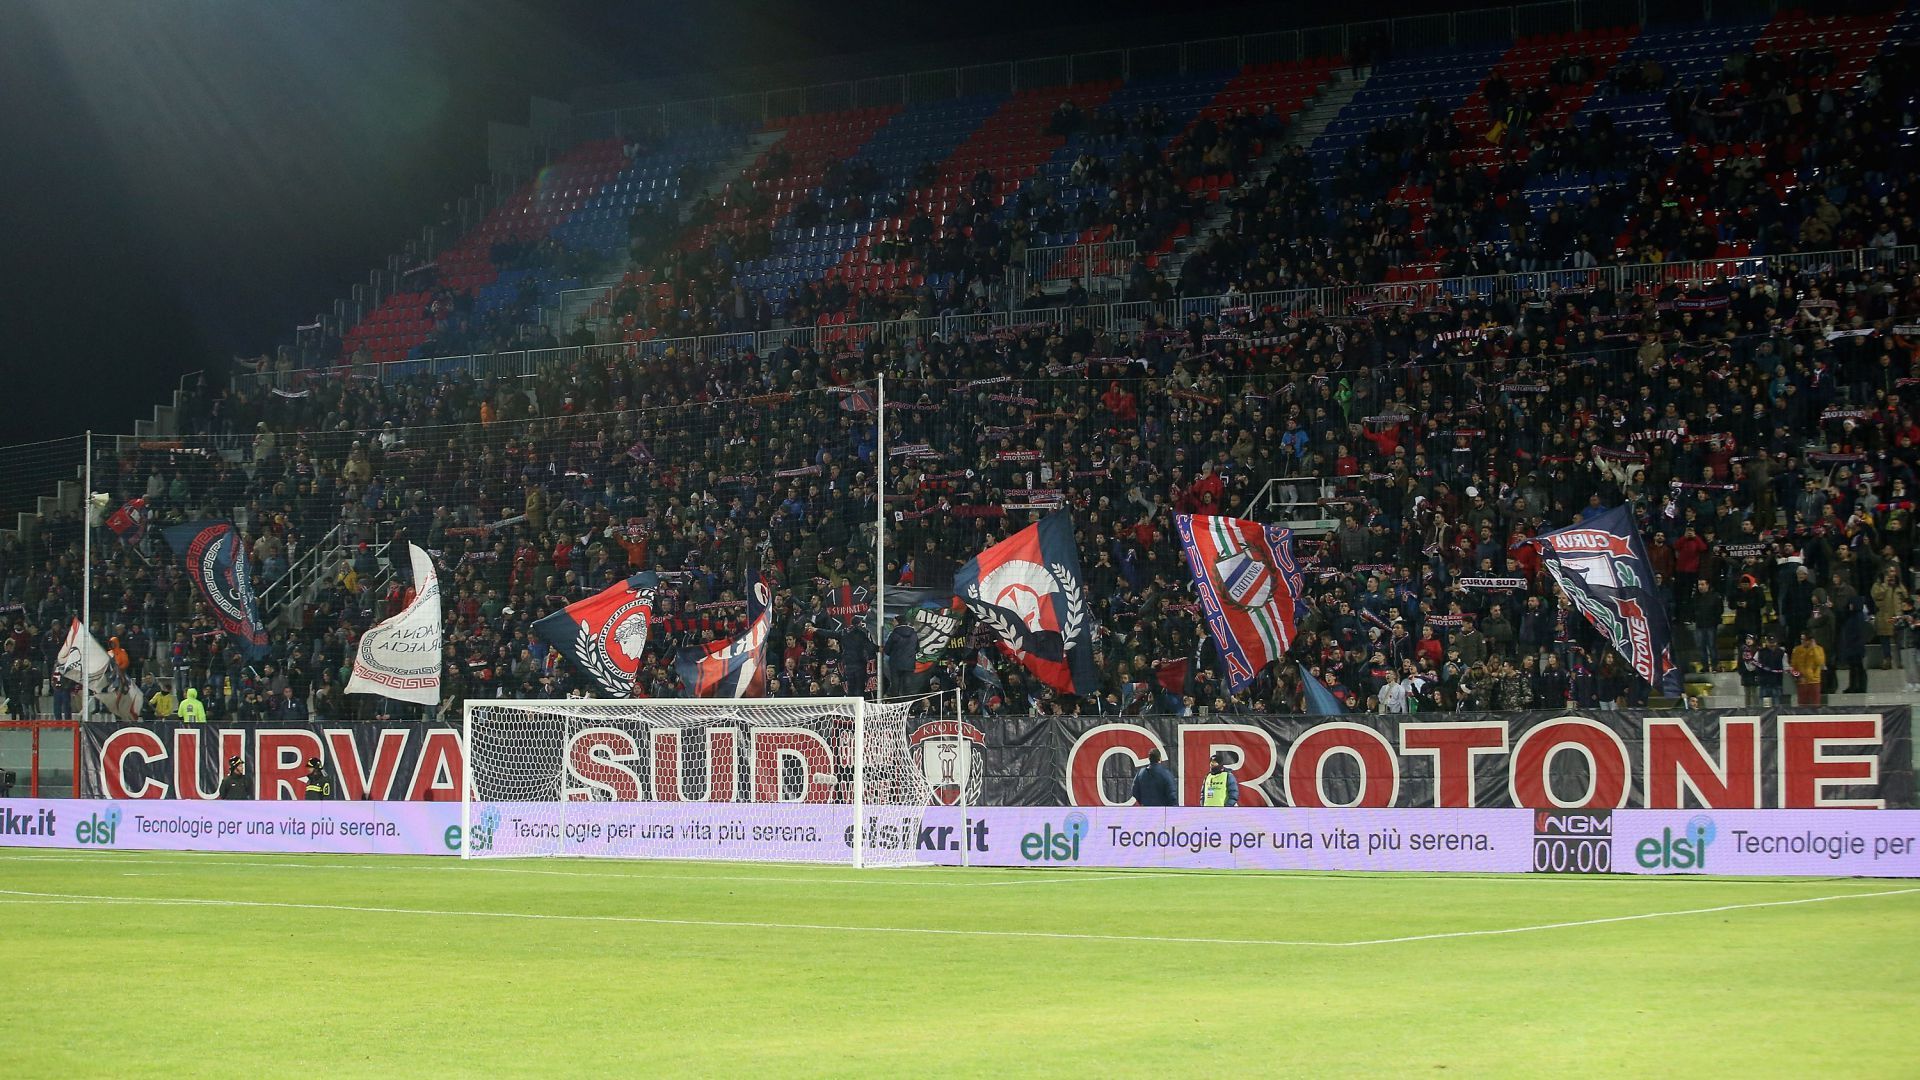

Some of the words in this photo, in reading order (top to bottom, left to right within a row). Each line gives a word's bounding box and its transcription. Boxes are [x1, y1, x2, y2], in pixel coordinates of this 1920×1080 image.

[1729, 549, 1762, 557] MERDA
[1630, 616, 1650, 681] OTONE
[101, 727, 479, 801] CURVA
[565, 727, 834, 803] SUD
[1065, 714, 1885, 809] CROTONE
[76, 812, 116, 844] elsi
[135, 815, 213, 838] Tecnologie
[218, 821, 242, 838] per
[247, 820, 275, 835] una
[279, 817, 305, 835] vita
[311, 817, 334, 839] più
[340, 821, 400, 837] serena.
[444, 815, 493, 850] esi
[511, 818, 601, 843] Tecnoogie
[607, 823, 636, 843] per
[641, 824, 674, 839] una
[680, 820, 712, 840] vita
[719, 820, 745, 845] più
[752, 825, 822, 842] serena.
[1107, 825, 1222, 853] Tecnologie
[1229, 830, 1267, 853] per
[1272, 831, 1313, 849] una
[1321, 827, 1360, 850] vita
[1369, 828, 1401, 855] più
[1409, 832, 1495, 851] serena.
[1544, 815, 1611, 833] NGM
[1020, 822, 1079, 861] elsi
[1534, 840, 1611, 873] 00:00
[1635, 827, 1704, 869] elsi
[1732, 831, 1864, 859] Tecnologie
[1874, 837, 1915, 860] per
